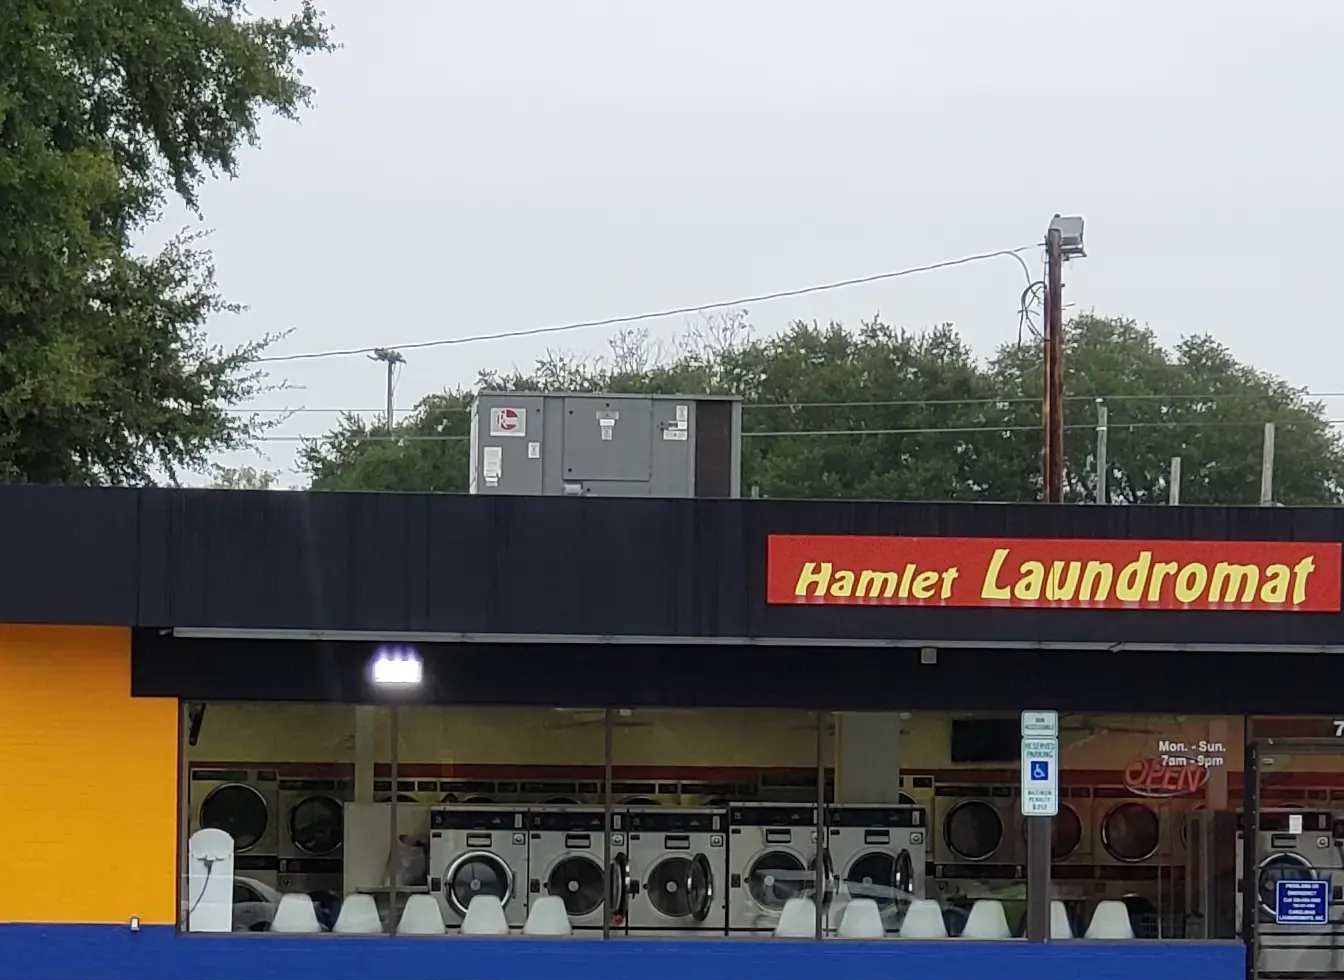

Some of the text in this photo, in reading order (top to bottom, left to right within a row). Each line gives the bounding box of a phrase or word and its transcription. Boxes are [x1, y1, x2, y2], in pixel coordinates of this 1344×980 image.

[795, 549, 1316, 605] Hamlet Laundromat
[1158, 740, 1188, 752] Mon.
[1198, 740, 1226, 752] Sun.
[1161, 755, 1187, 766] 7am
[1197, 754, 1224, 769] 9pm
[1124, 757, 1203, 793] OPEN
